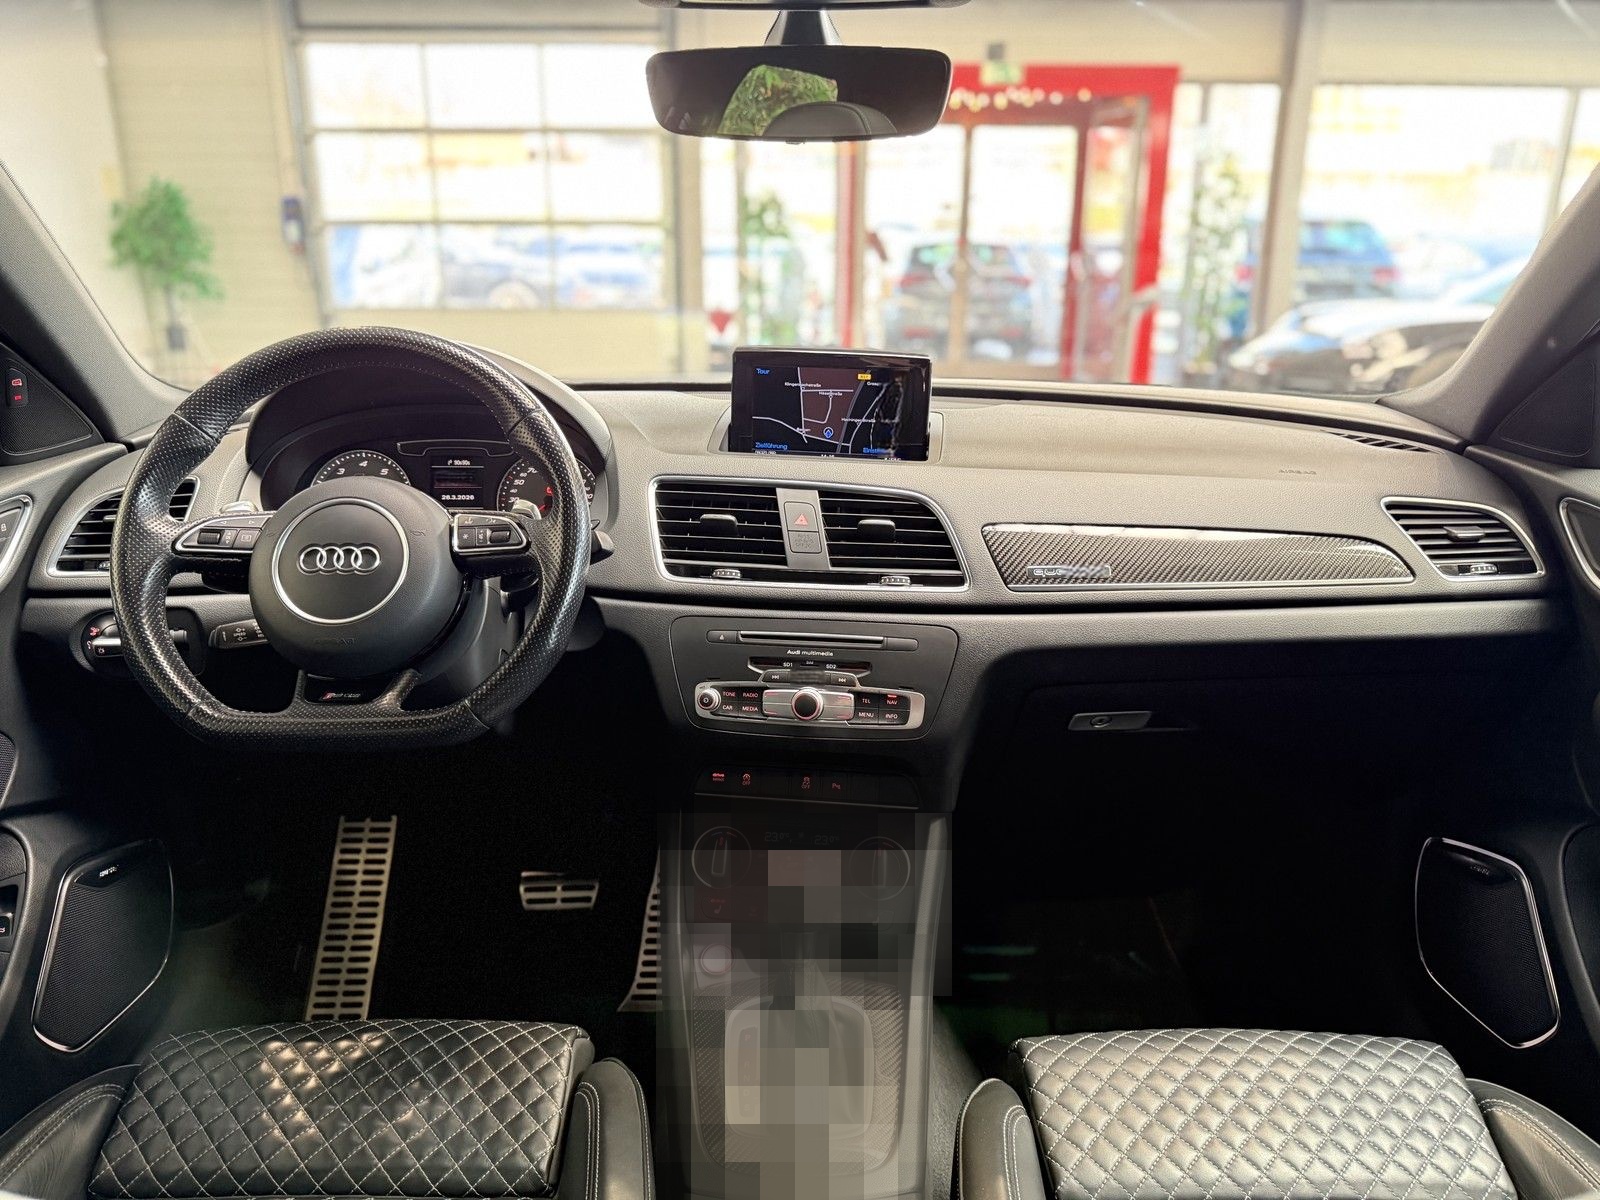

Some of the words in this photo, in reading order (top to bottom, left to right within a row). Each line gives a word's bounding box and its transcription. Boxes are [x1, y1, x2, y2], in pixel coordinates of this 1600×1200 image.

[755, 441, 788, 451] Zielführung
[336, 467, 346, 475] 3
[380, 468, 389, 476] 5
